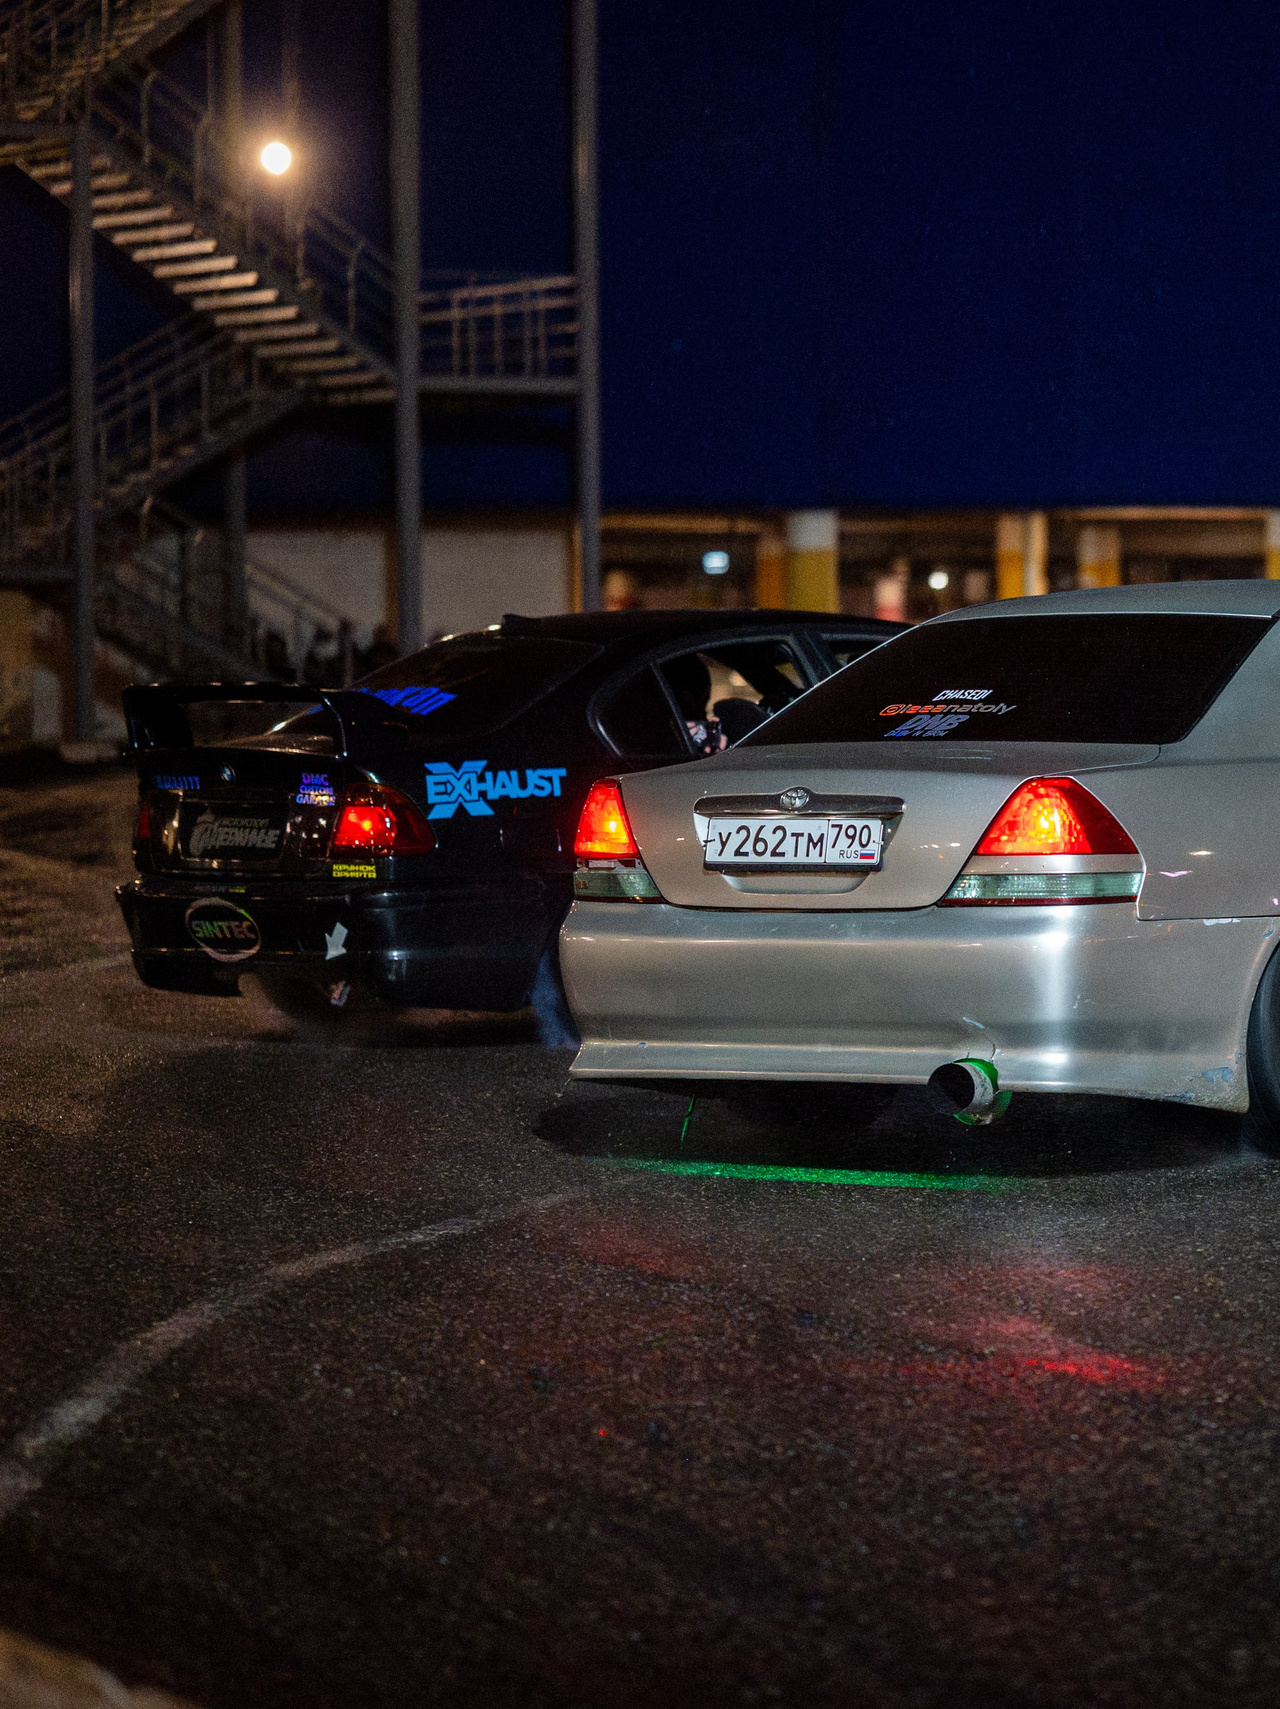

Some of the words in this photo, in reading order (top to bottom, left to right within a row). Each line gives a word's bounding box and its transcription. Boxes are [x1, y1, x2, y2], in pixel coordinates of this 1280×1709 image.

[423, 759, 568, 820] EXHAUST
[830, 823, 872, 849] 790
[838, 849, 860, 859] RUS
[191, 920, 256, 939] SINTEC
